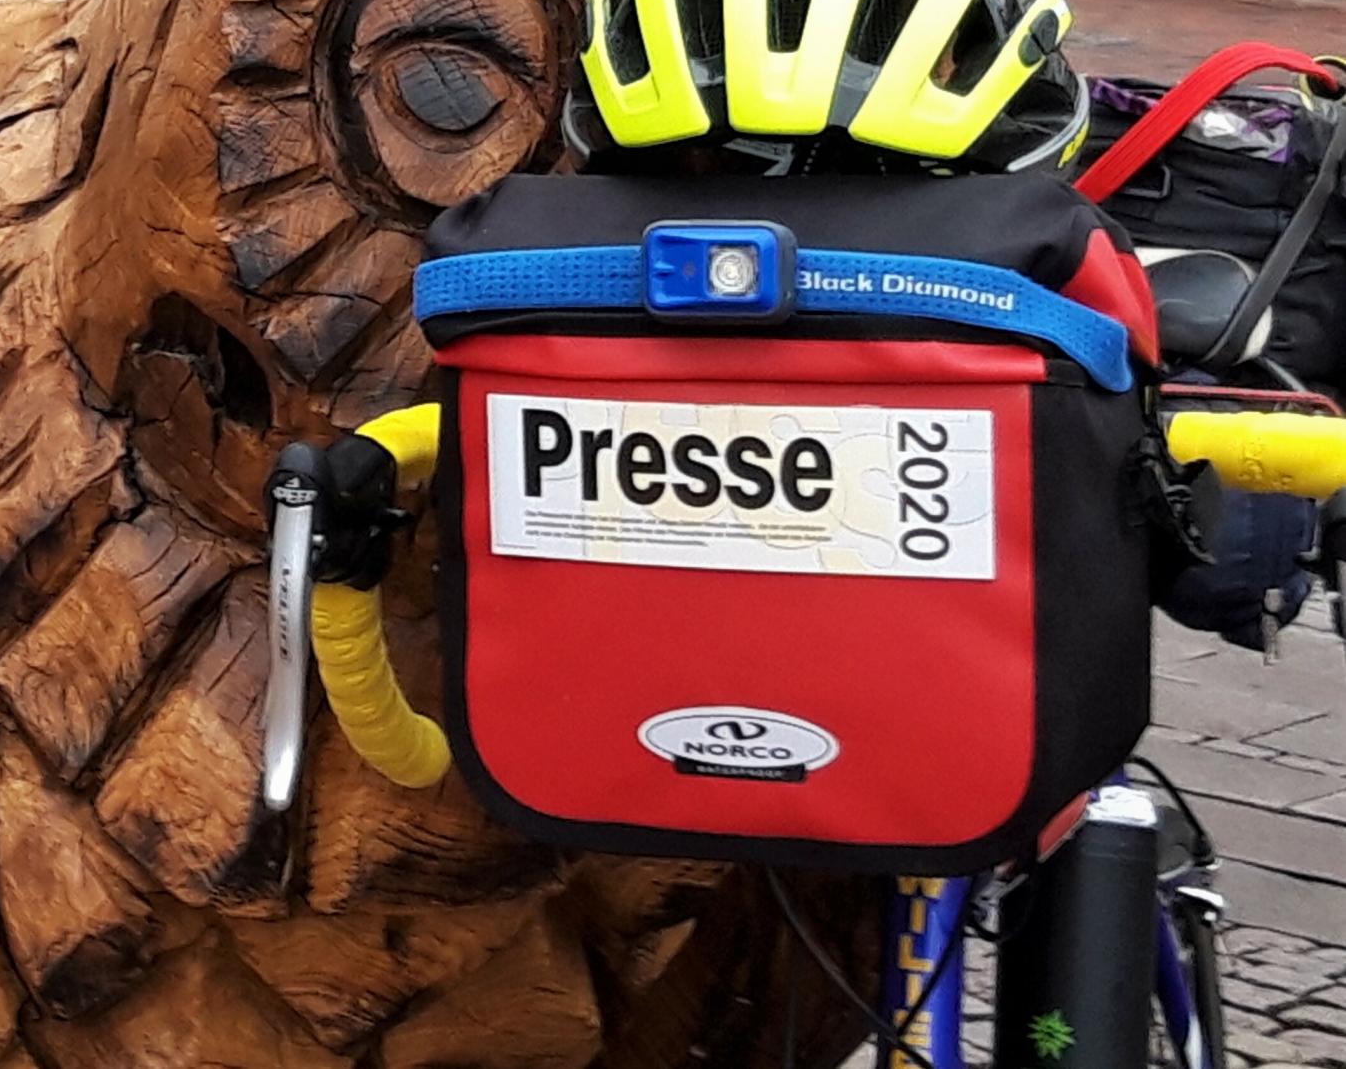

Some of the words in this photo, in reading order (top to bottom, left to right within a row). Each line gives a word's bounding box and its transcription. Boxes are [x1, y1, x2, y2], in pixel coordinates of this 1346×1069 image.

[795, 270, 874, 293] Black
[882, 273, 1015, 311] Diamond
[521, 407, 834, 512] Presse
[897, 421, 951, 562] 2020
[683, 742, 793, 761] NORCO
